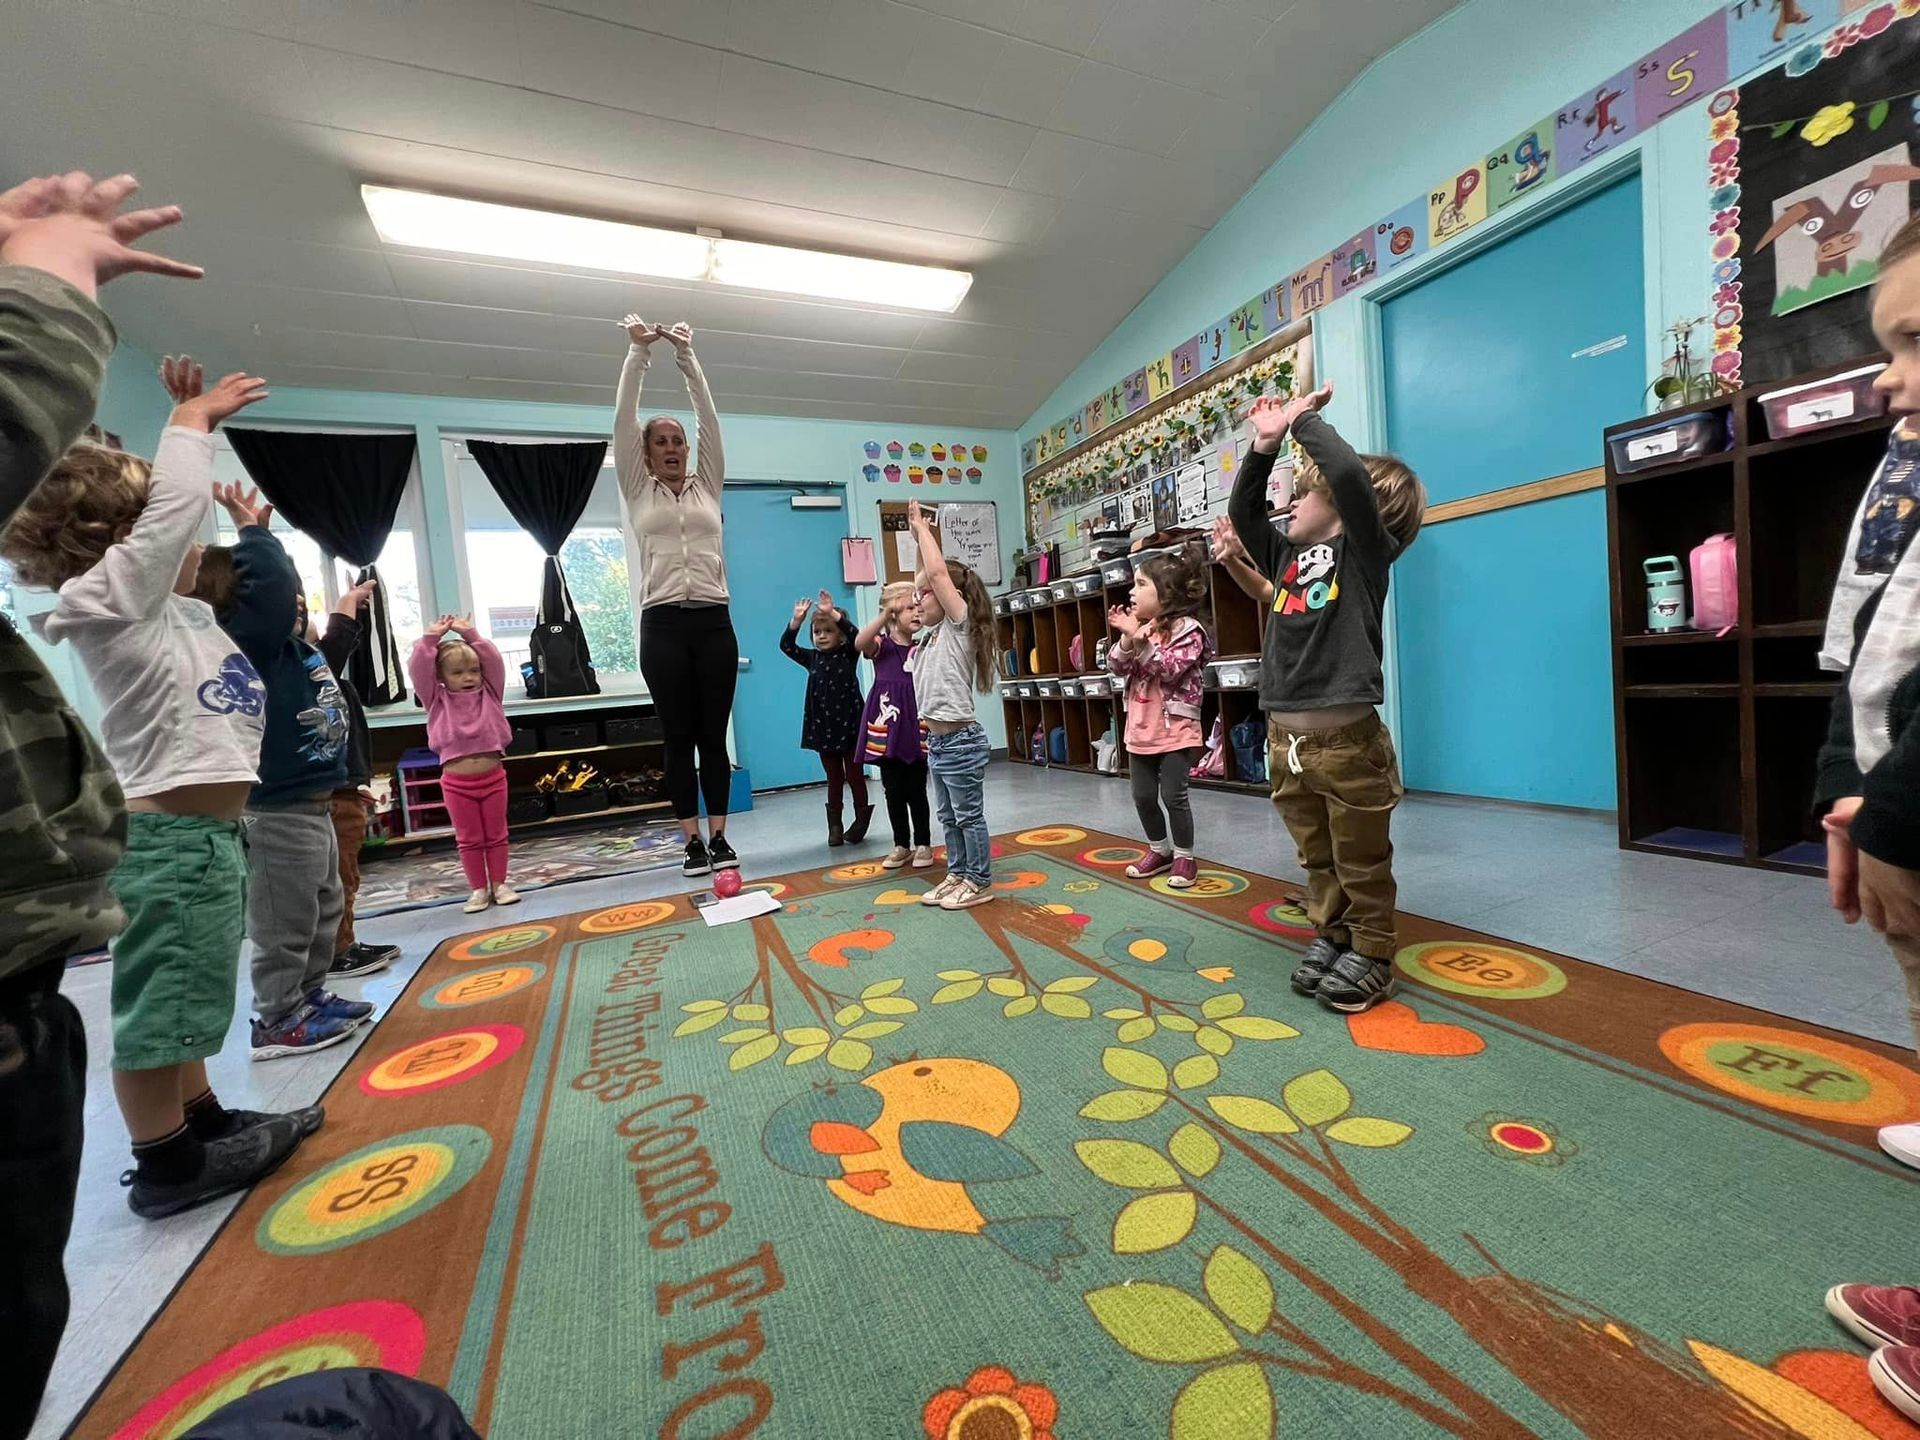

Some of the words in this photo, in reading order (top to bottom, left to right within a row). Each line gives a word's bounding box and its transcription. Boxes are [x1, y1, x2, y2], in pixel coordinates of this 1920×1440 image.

[944, 516, 968, 529] Letter
[971, 518, 980, 527] of
[840, 864, 877, 879] Yy
[606, 932, 686, 994] Great
[1434, 951, 1515, 982] Ee
[572, 992, 664, 1103] Things
[1715, 1045, 1857, 1095] Ff
[327, 1154, 419, 1213] Ss
[616, 1093, 733, 1249] Come
